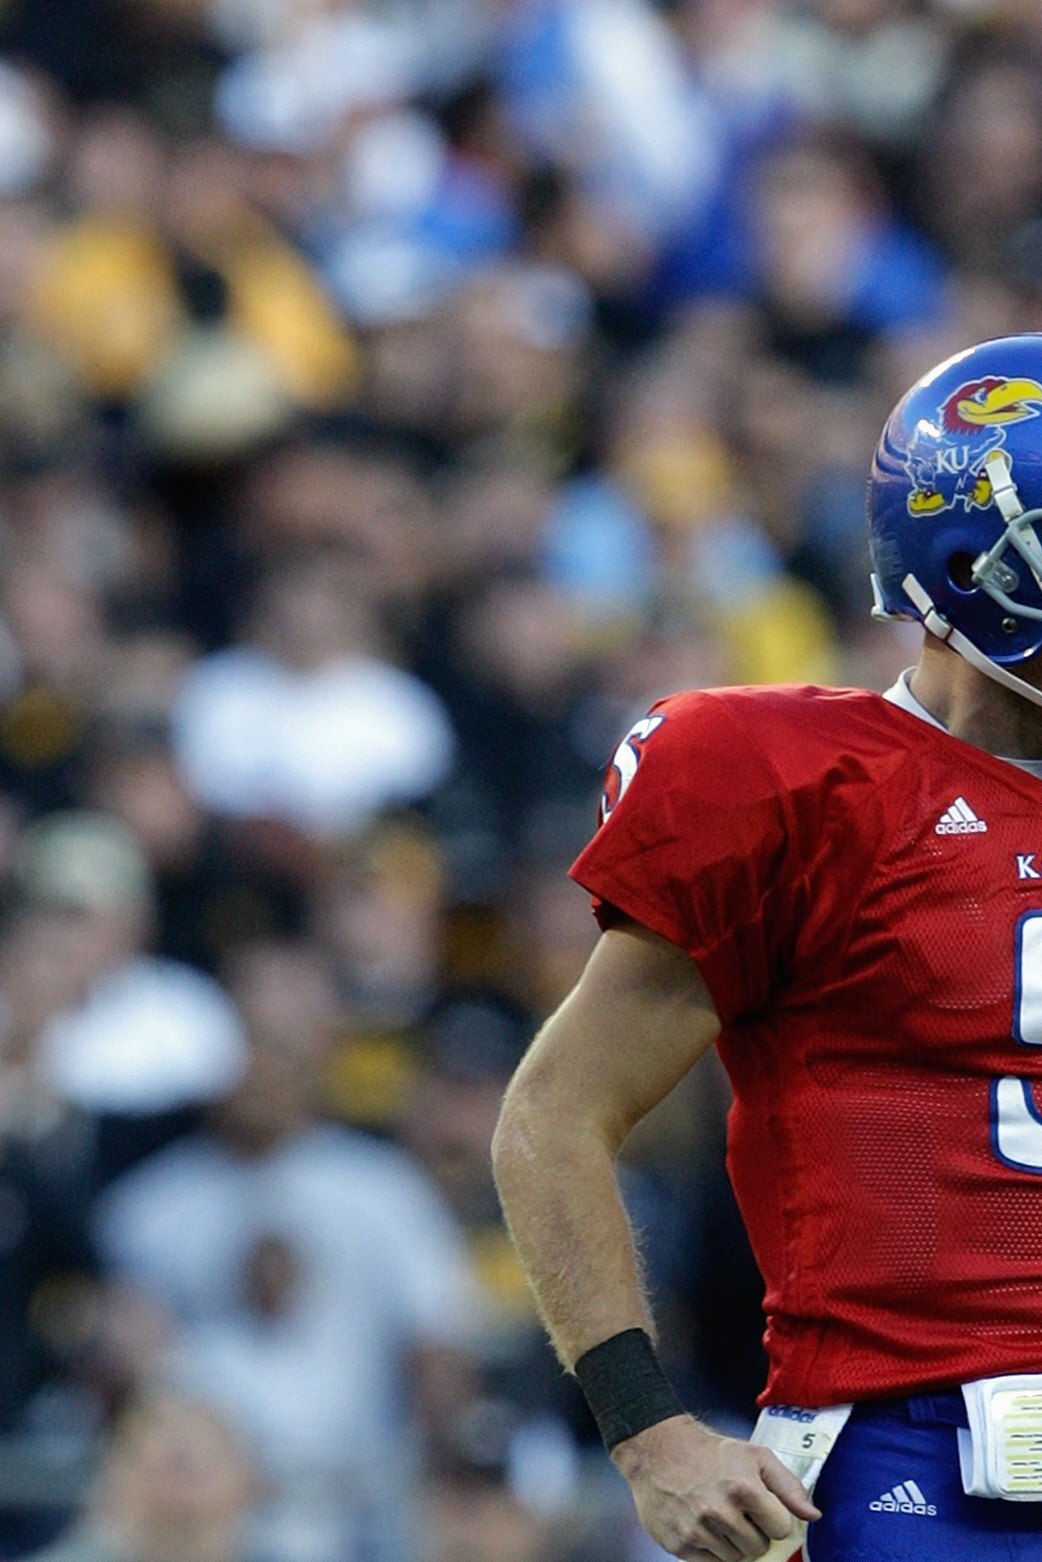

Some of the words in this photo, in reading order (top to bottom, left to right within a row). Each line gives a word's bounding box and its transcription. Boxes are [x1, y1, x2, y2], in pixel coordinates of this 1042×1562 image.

[936, 445, 970, 474] KU
[935, 820, 988, 835] adidas
[802, 1432, 816, 1449] 5
[869, 1500, 937, 1516] adidas
